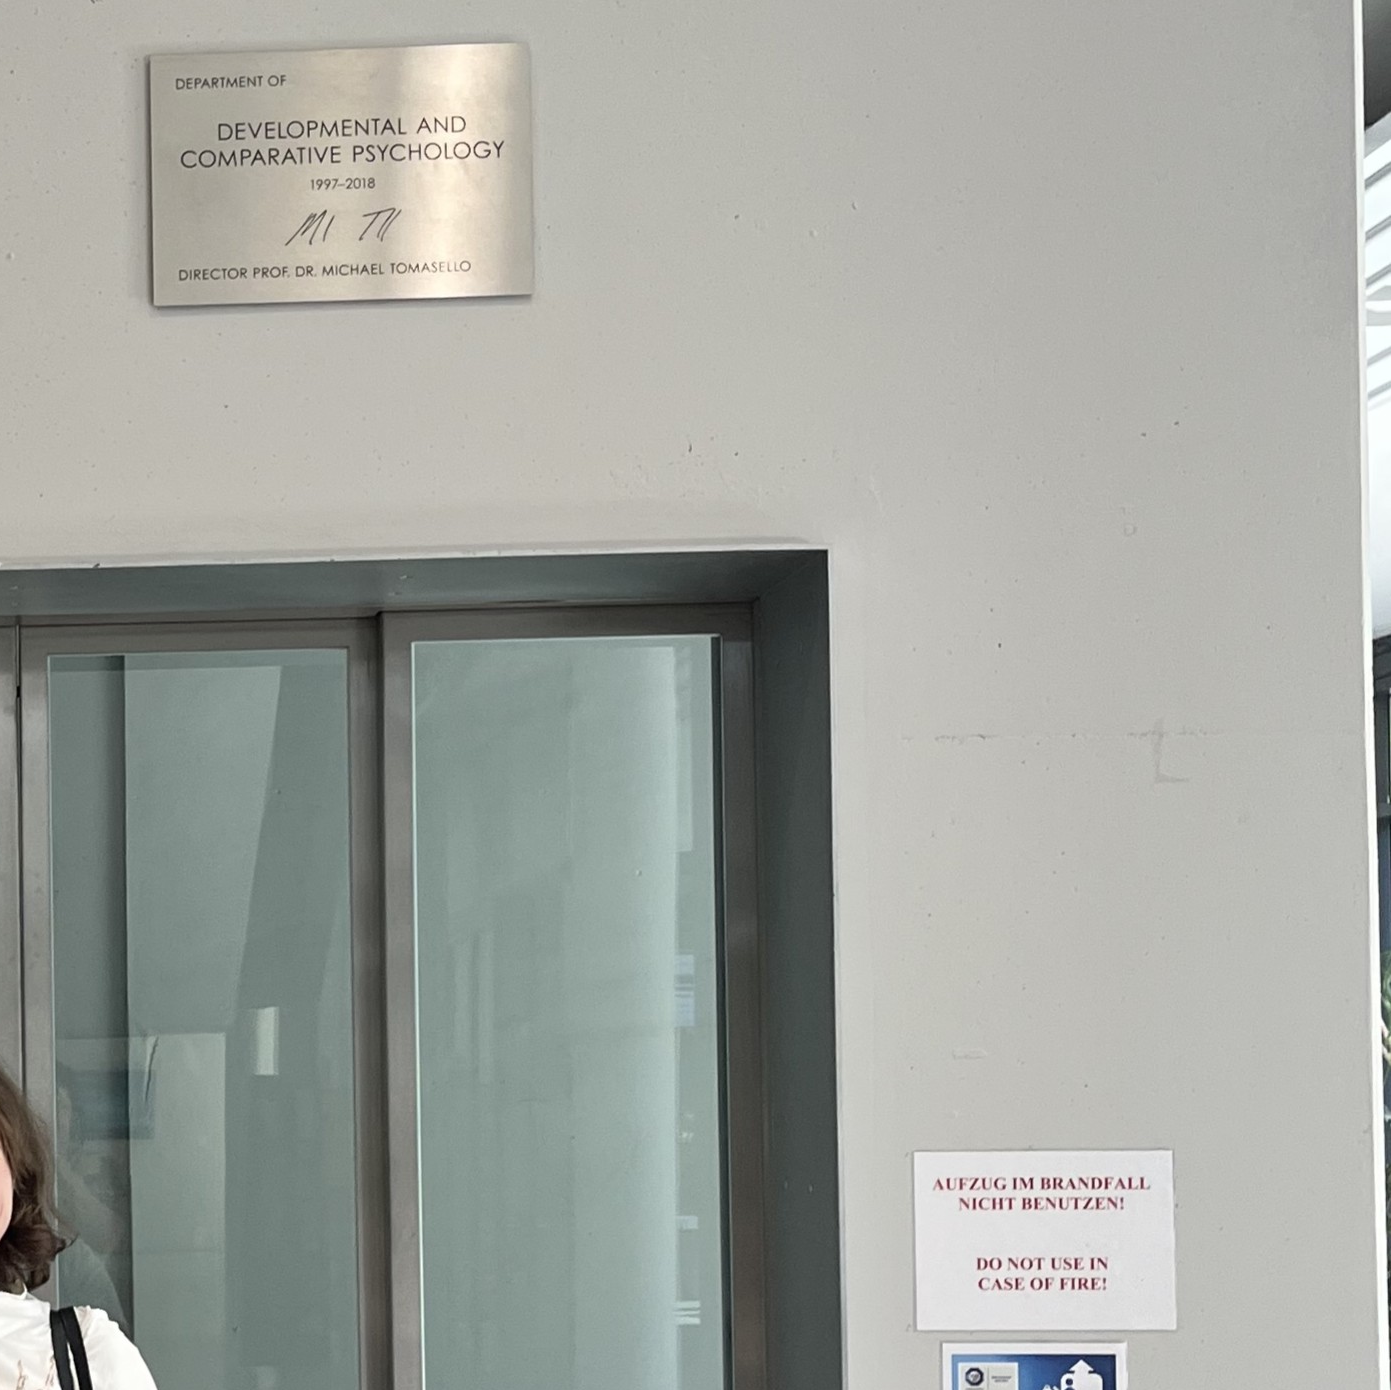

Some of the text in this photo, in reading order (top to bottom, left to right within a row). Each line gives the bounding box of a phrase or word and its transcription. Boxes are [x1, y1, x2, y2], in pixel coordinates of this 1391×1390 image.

[175, 74, 287, 90] DEPARTMENT OF
[217, 115, 467, 141] DEVELOPMENTAL AND
[179, 140, 505, 169] COMPARATIVE PSYCHOLOGY
[178, 260, 472, 282] DIRECTOR PROF. DR. MICHAEL TOMASELLO
[932, 1176, 1151, 1191] AUFZUG IM BRANDFALL
[958, 1197, 1125, 1211] NICHT BENUTZEN!
[976, 1257, 1109, 1271] DO NOT USE IN
[977, 1277, 1107, 1291] CASE OF FIRE!
